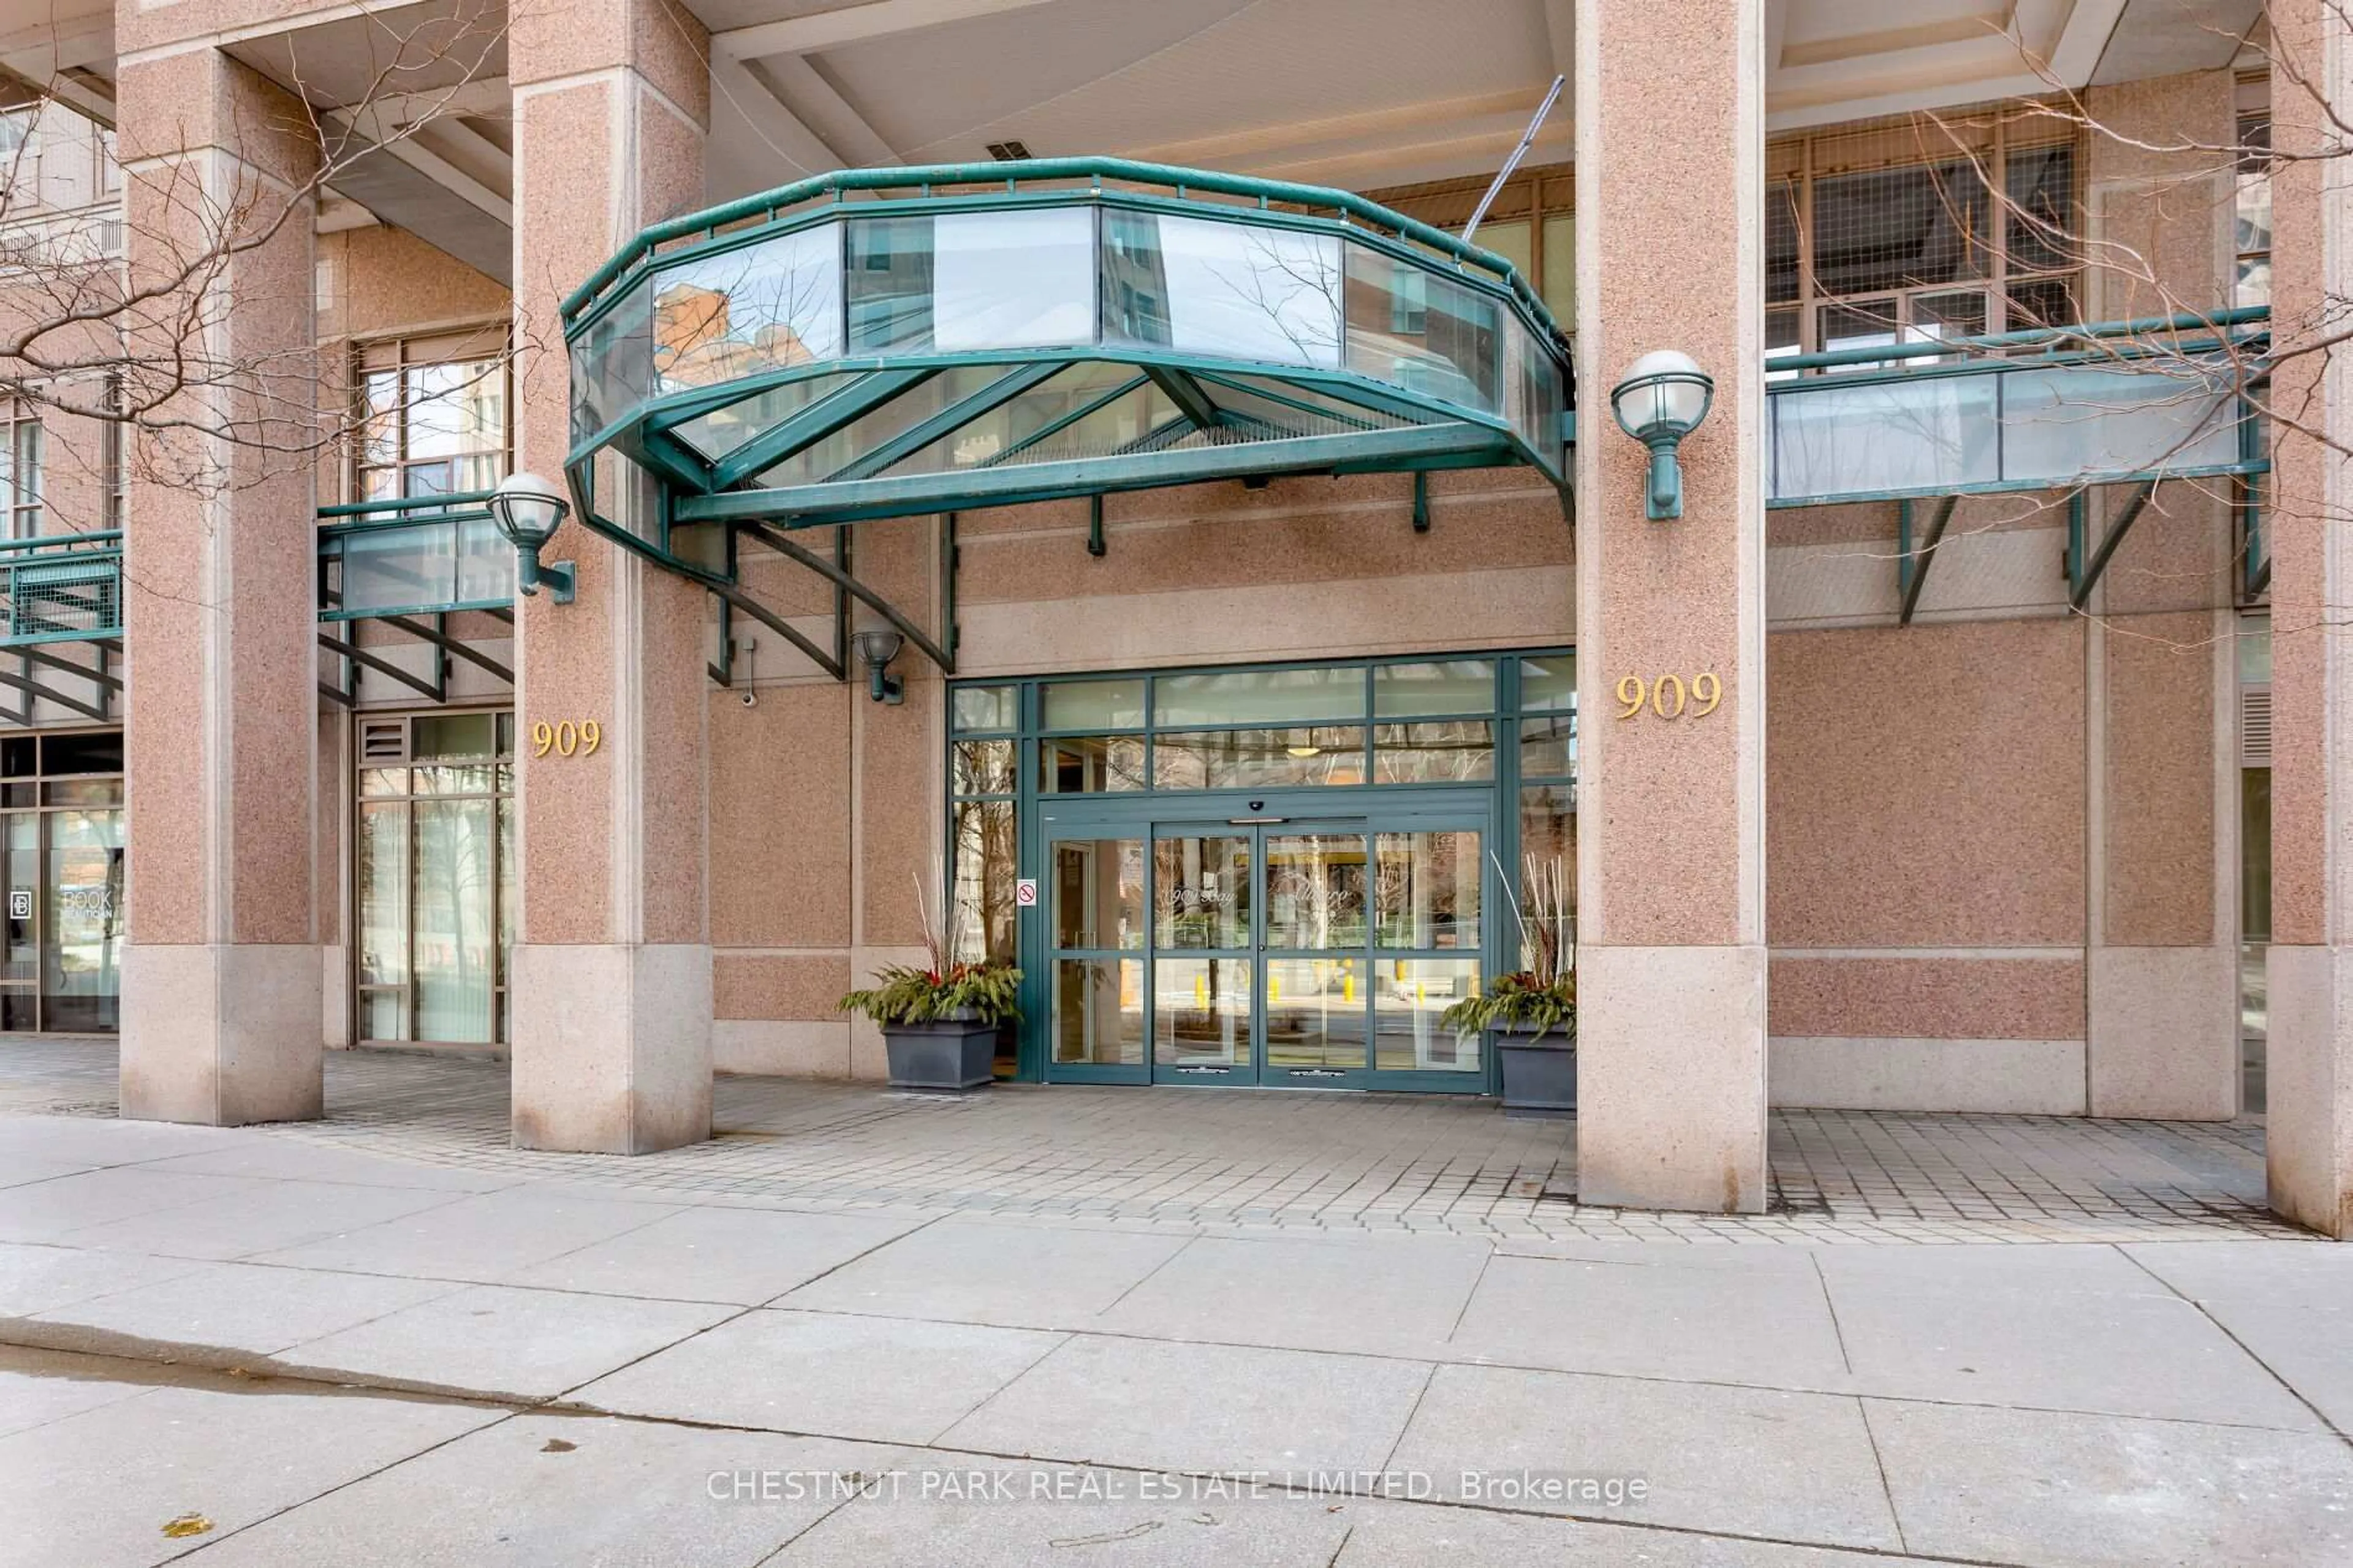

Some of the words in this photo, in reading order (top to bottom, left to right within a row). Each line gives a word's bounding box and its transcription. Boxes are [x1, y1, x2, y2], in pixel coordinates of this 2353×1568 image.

[1615, 673, 1721, 719] 909
[534, 719, 601, 757] 909
[64, 890, 112, 909] BOOK
